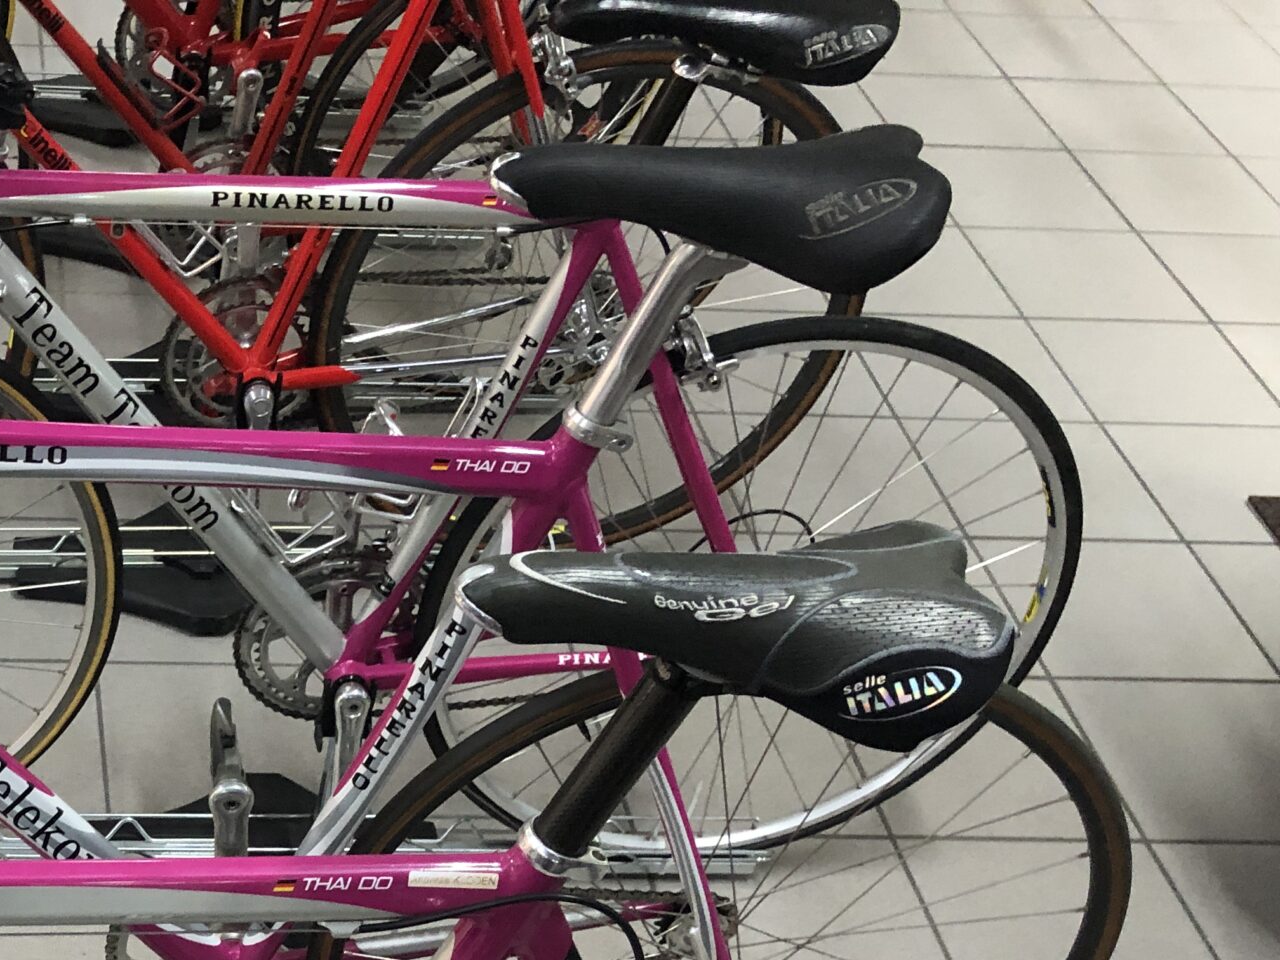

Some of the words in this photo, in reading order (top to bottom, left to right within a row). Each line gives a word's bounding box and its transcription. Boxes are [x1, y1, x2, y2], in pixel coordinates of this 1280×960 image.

[210, 191, 395, 213] PINARELLO
[13, 286, 102, 399] Team
[455, 459, 496, 472] THAI
[500, 460, 531, 474] DO
[653, 592, 758, 609] Genuine
[694, 594, 796, 623] Gel
[841, 673, 887, 695] selle
[844, 671, 947, 717] ITALIA
[351, 618, 467, 790] PINARELLO
[302, 876, 352, 892] THAI
[357, 876, 394, 891] DO
